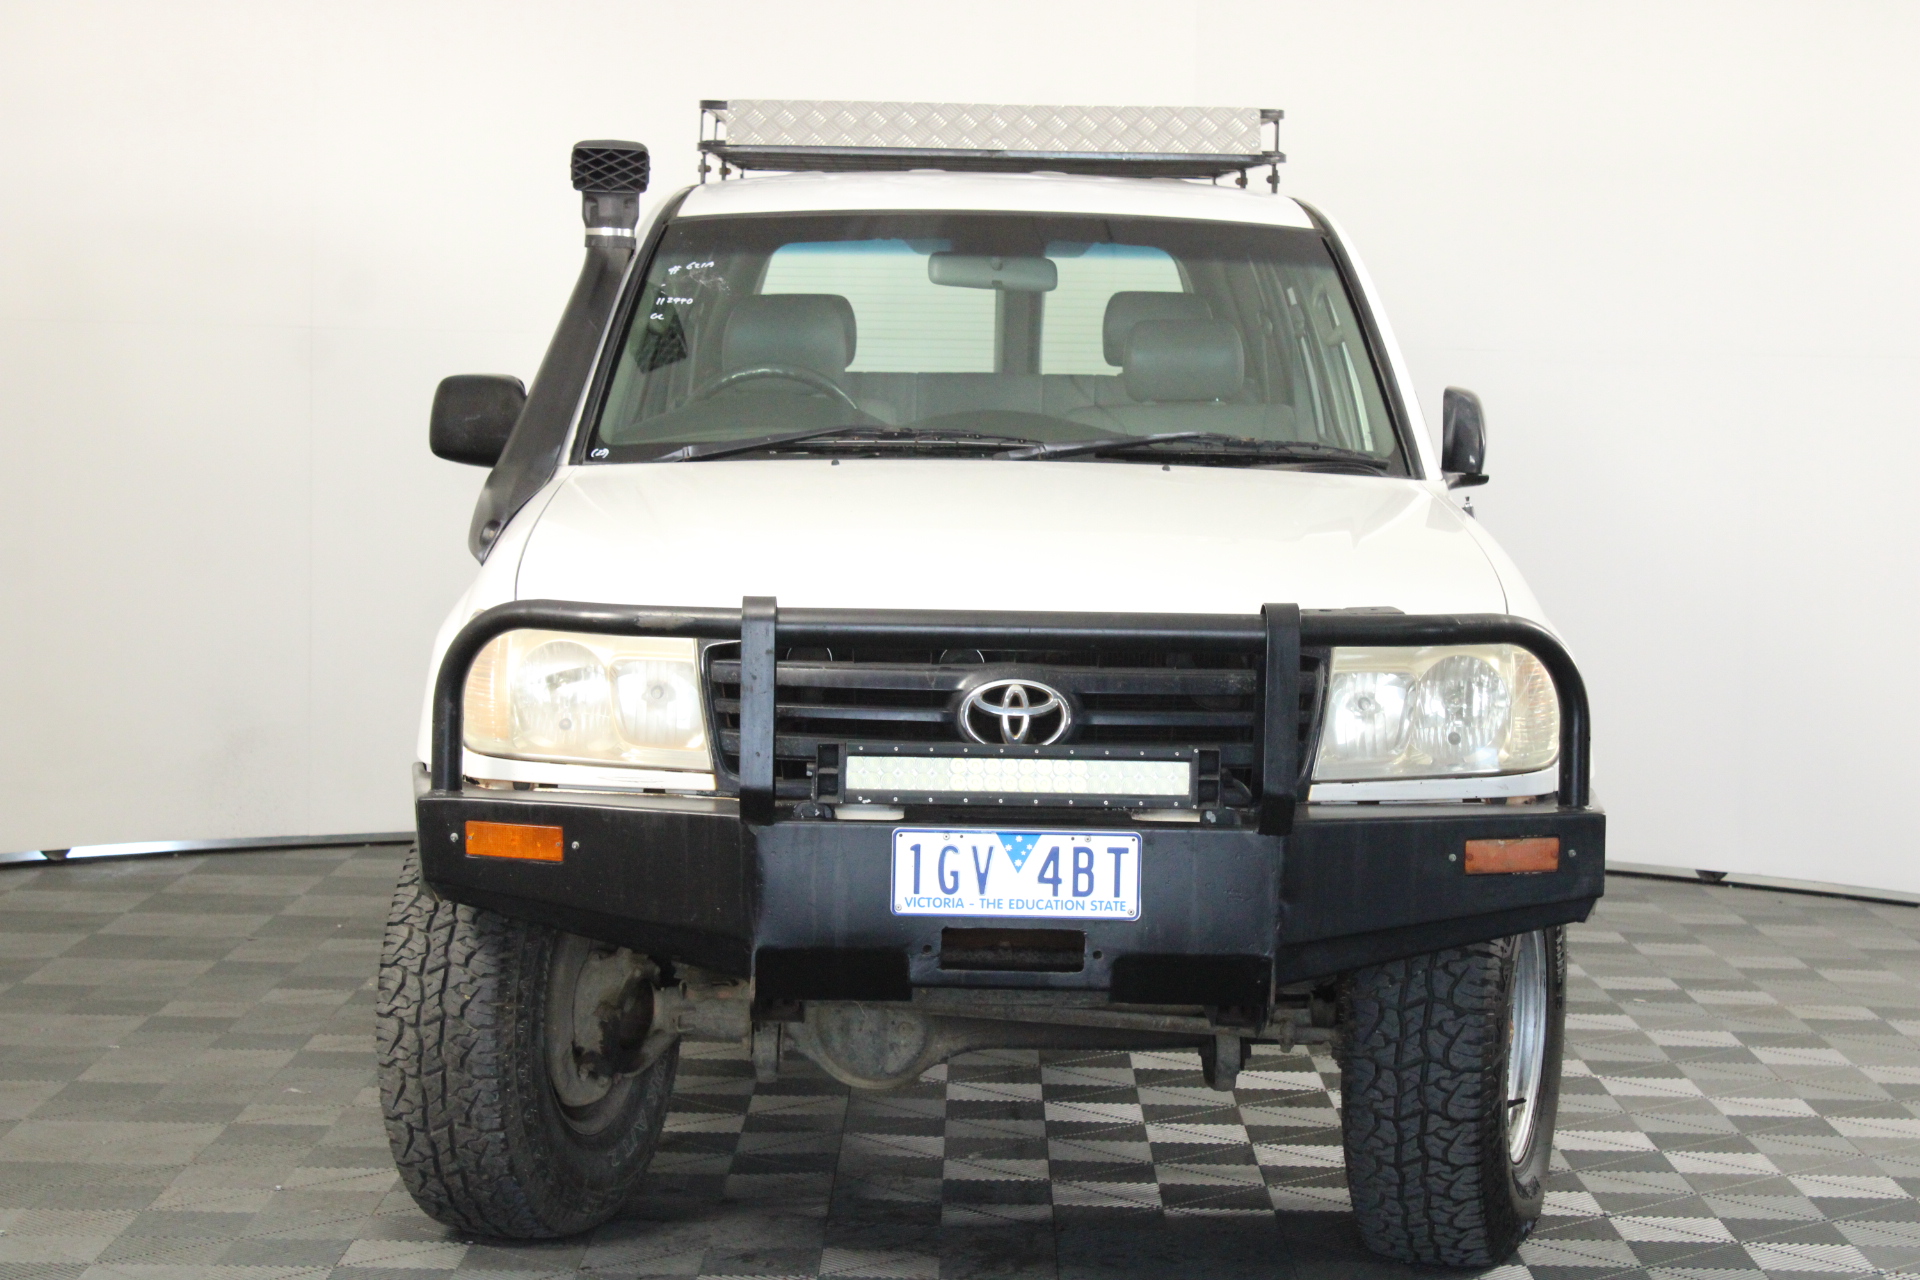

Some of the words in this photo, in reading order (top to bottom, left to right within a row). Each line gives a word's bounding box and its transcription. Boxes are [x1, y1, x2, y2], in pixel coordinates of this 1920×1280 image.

[904, 896, 965, 909] VICTORIA
[980, 897, 1004, 910] THE
[1008, 898, 1085, 912] EDUCATION
[1090, 900, 1127, 912] STATE
